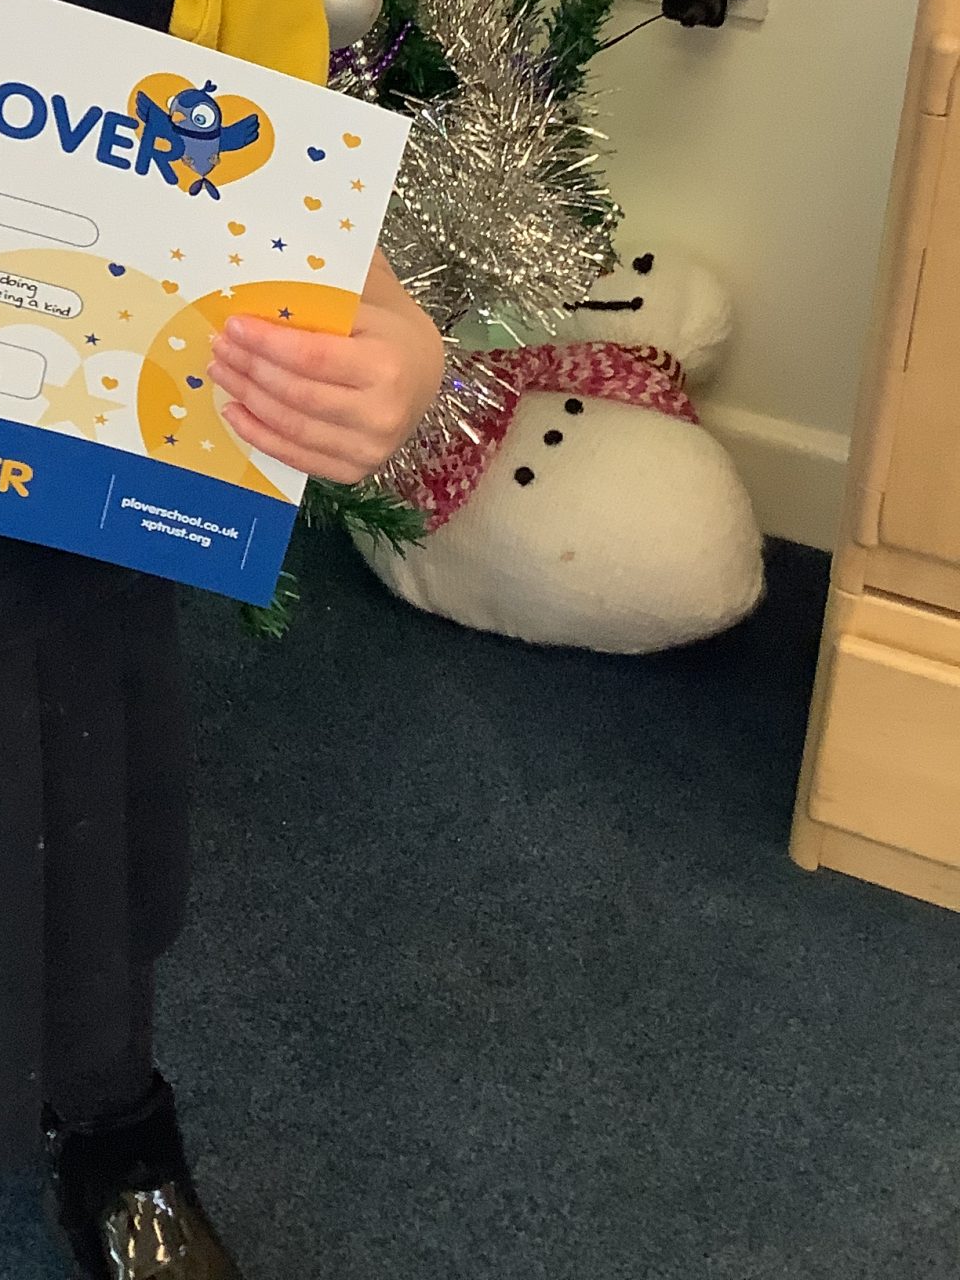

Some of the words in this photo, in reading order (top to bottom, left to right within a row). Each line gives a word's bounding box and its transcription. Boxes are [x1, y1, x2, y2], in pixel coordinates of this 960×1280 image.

[0, 275, 38, 299] doing
[28, 298, 38, 308] a
[44, 302, 72, 317] kind
[121, 497, 239, 539] ploverschool.co.uk
[141, 518, 212, 548] xptrust.org
